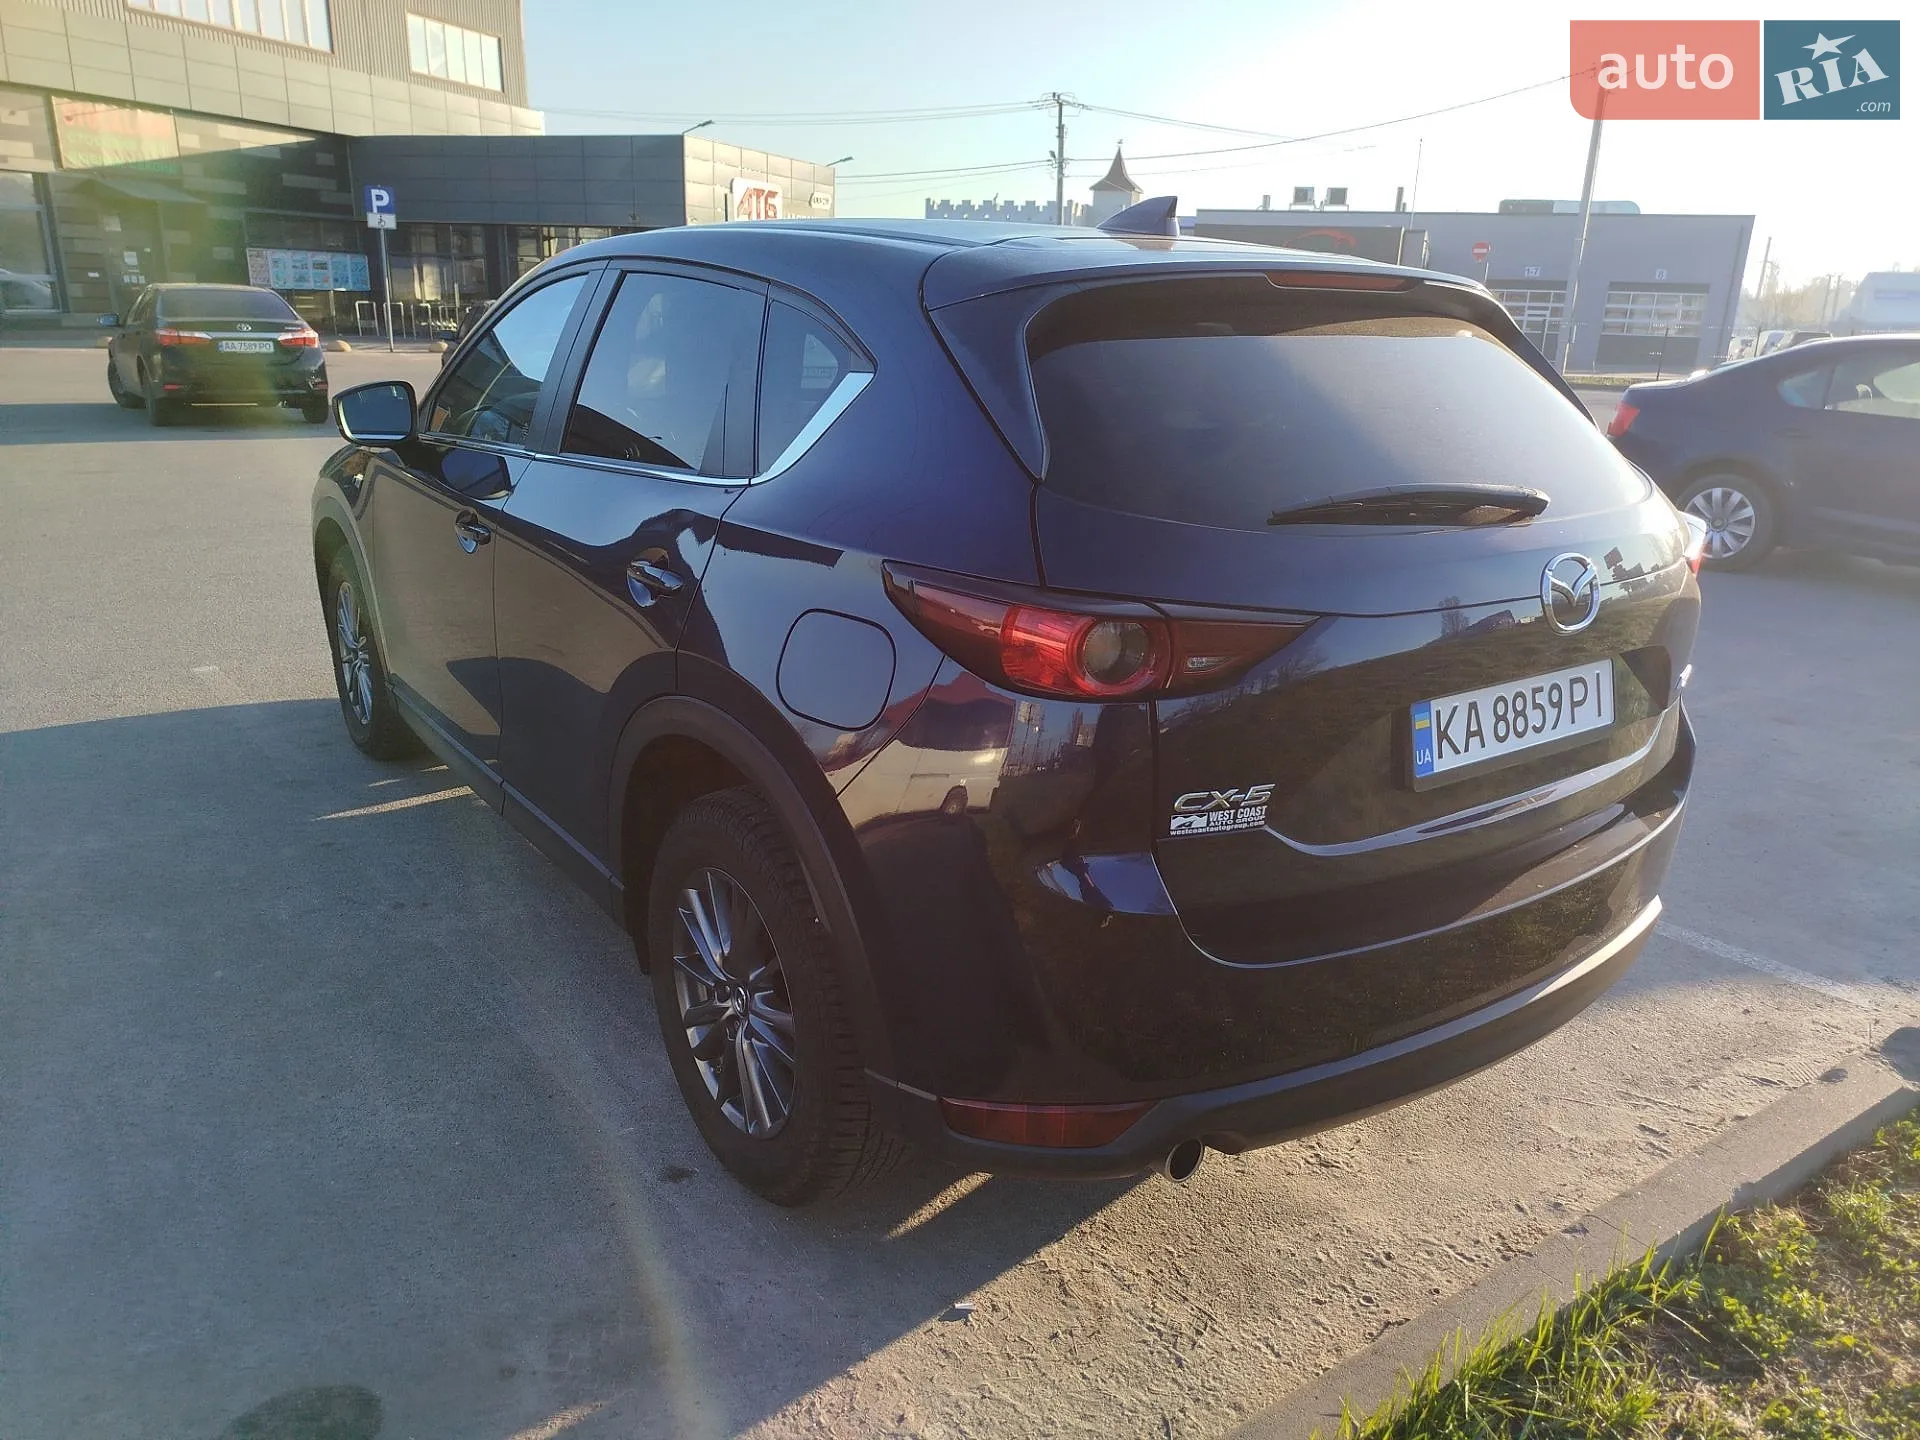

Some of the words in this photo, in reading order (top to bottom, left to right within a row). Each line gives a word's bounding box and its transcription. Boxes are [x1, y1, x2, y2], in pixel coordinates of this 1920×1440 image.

[371, 189, 390, 214] P
[1435, 700, 1486, 759] KA
[1493, 682, 1563, 743] 8859
[1416, 748, 1432, 765] UA
[1174, 783, 1276, 813] CX-5
[1209, 809, 1236, 822] WEST
[1237, 805, 1268, 818] COAST
[1209, 819, 1234, 827] AUTO
[1235, 815, 1266, 824] GROUP
[1170, 820, 1265, 836] westcoastautogroup.com
